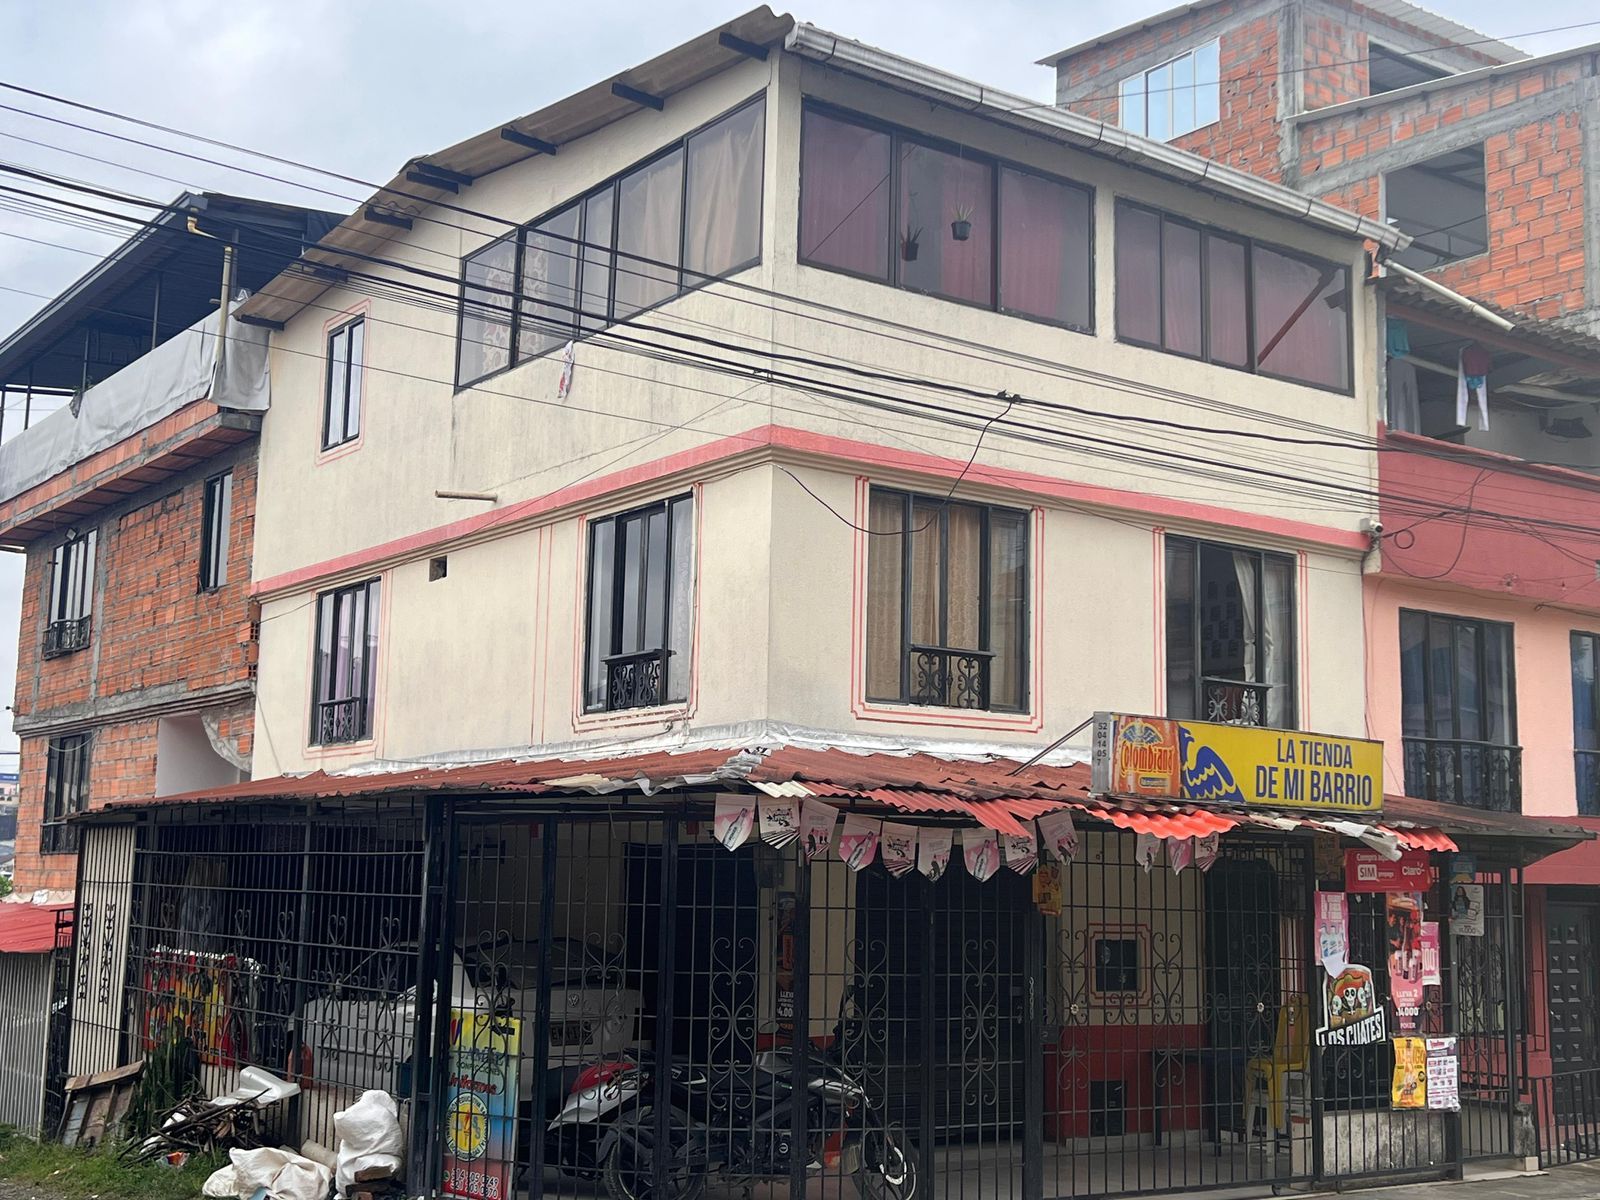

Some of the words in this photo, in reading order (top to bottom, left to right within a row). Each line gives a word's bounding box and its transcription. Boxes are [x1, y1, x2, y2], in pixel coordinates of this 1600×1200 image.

[1098, 722, 1107, 730] 52
[1097, 731, 1106, 739] 04
[1097, 740, 1107, 748] 14
[1097, 750, 1107, 758] 05
[1120, 740, 1175, 777] Colombiana
[1277, 738, 1296, 763] LA
[1300, 740, 1353, 769] TIENDA
[1255, 765, 1279, 799] DE
[1284, 768, 1305, 801] MI
[1310, 770, 1373, 806] BARRIO
[1360, 866, 1376, 878] SIM
[1402, 865, 1422, 876] Claro
